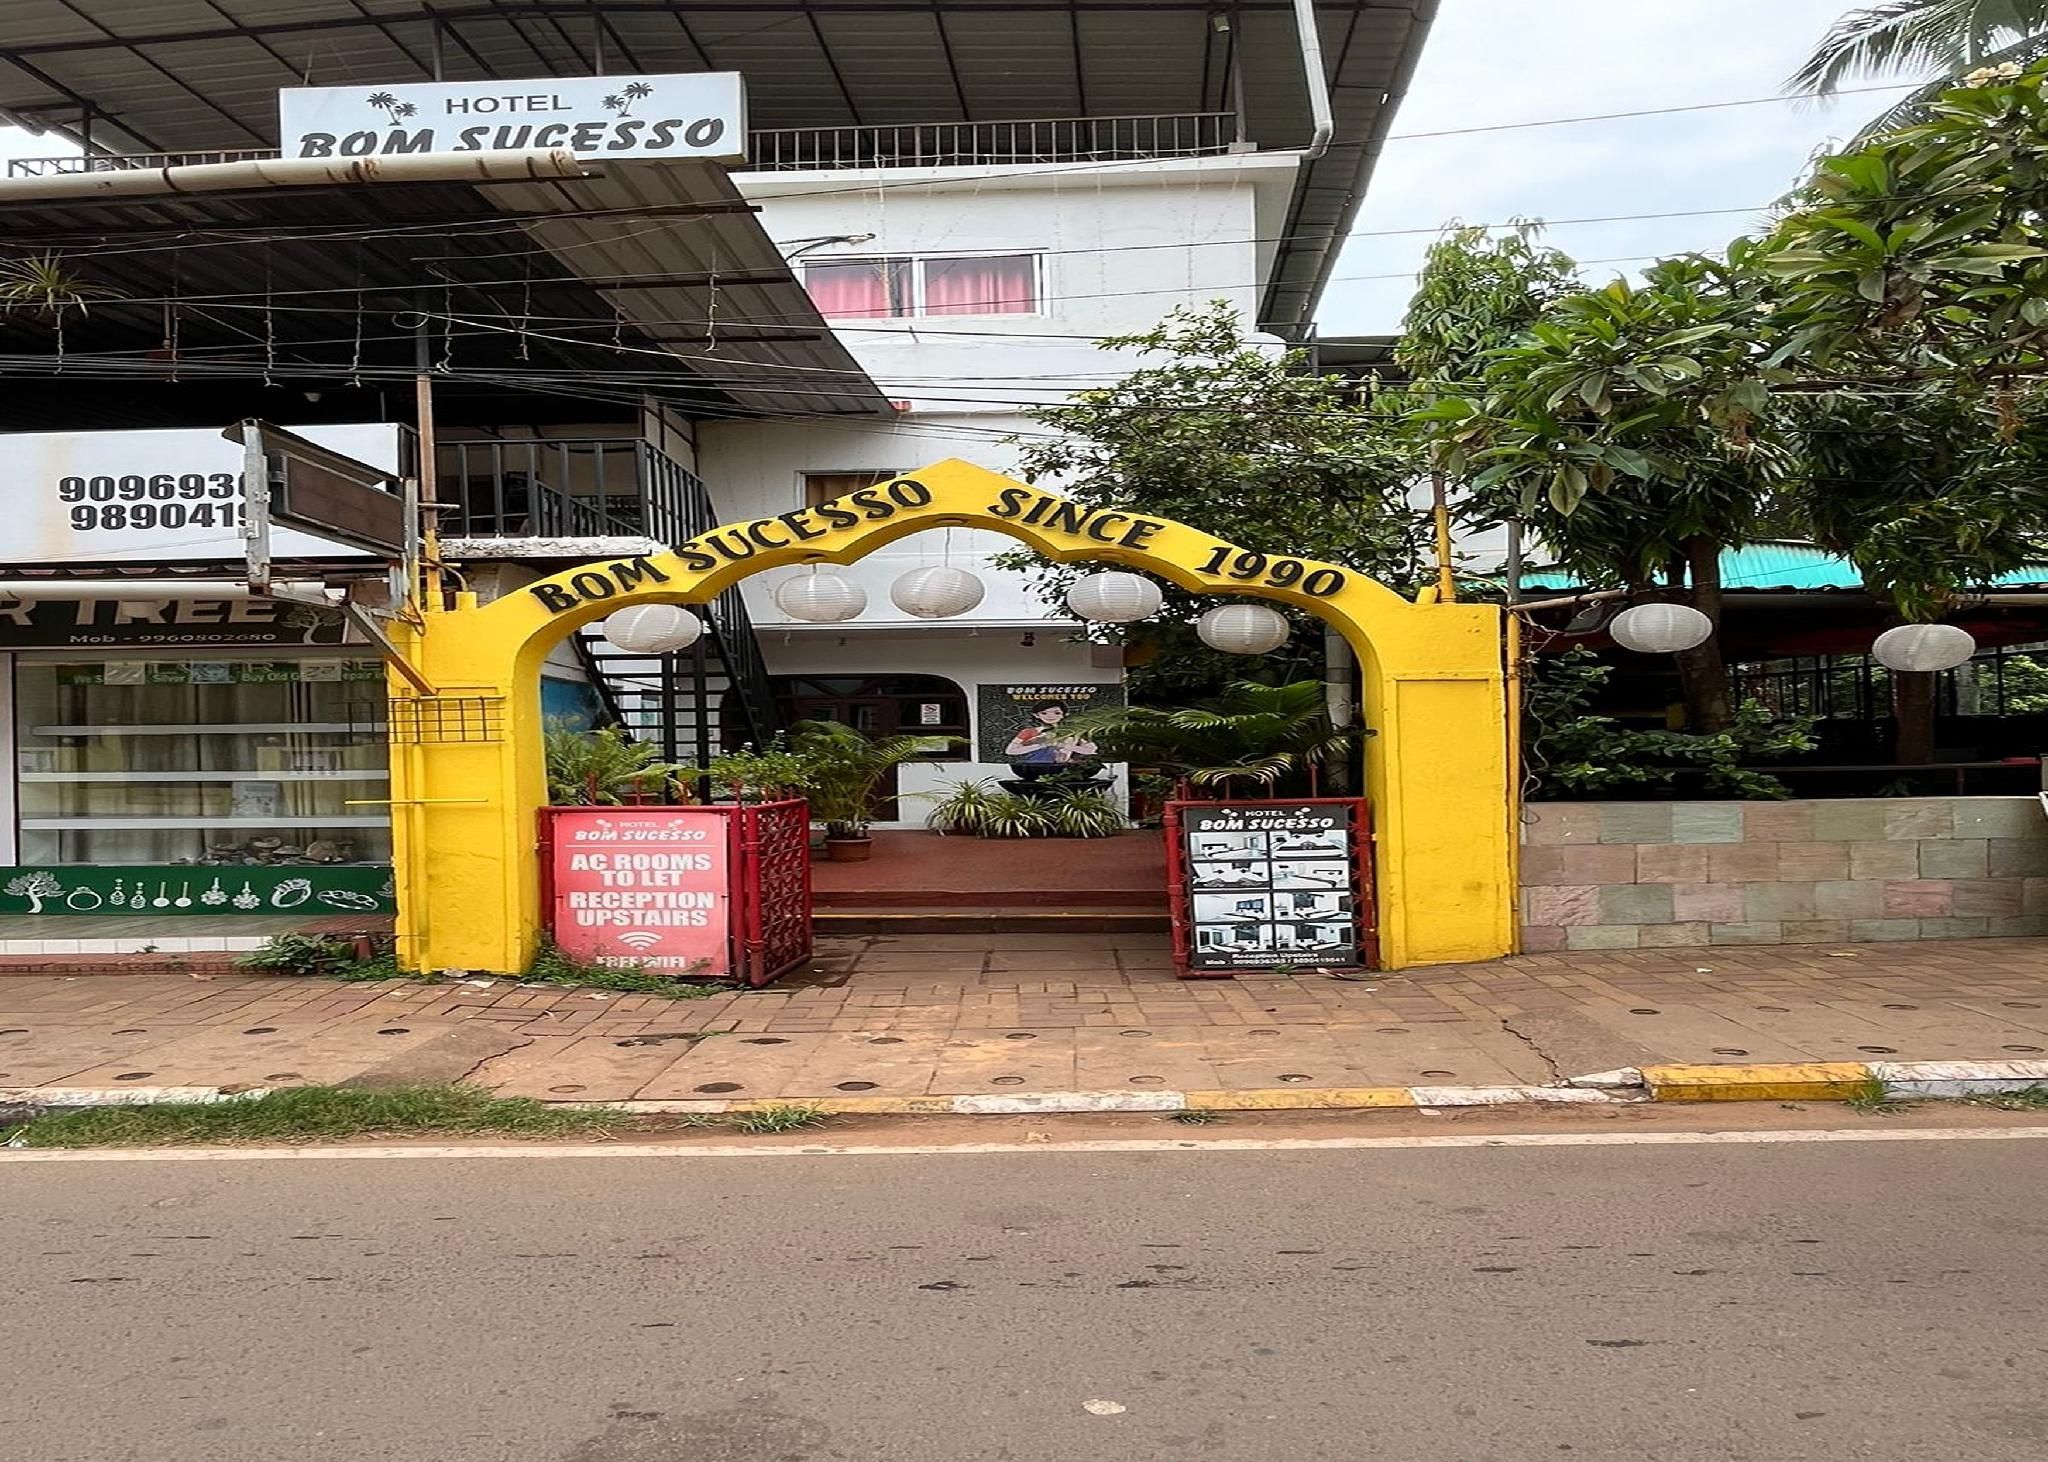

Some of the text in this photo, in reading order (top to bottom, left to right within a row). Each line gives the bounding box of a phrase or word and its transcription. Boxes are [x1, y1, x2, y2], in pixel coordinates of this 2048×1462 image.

[445, 94, 573, 115] HOTEL
[300, 117, 726, 157] BOM SUCESSO
[529, 478, 1347, 615] BOM SUCESSO SINCE 1990
[69, 634, 116, 644] Mob
[1007, 686, 1098, 694] BOM SUCESSO
[1199, 817, 1335, 831] BOM SUCESSO
[574, 829, 706, 841] BOM SUCESSO
[571, 853, 713, 872] AC ROOMS
[600, 870, 684, 887] TO LET
[569, 891, 715, 909] RECEPTION
[576, 909, 709, 927] UPSTAIRS
